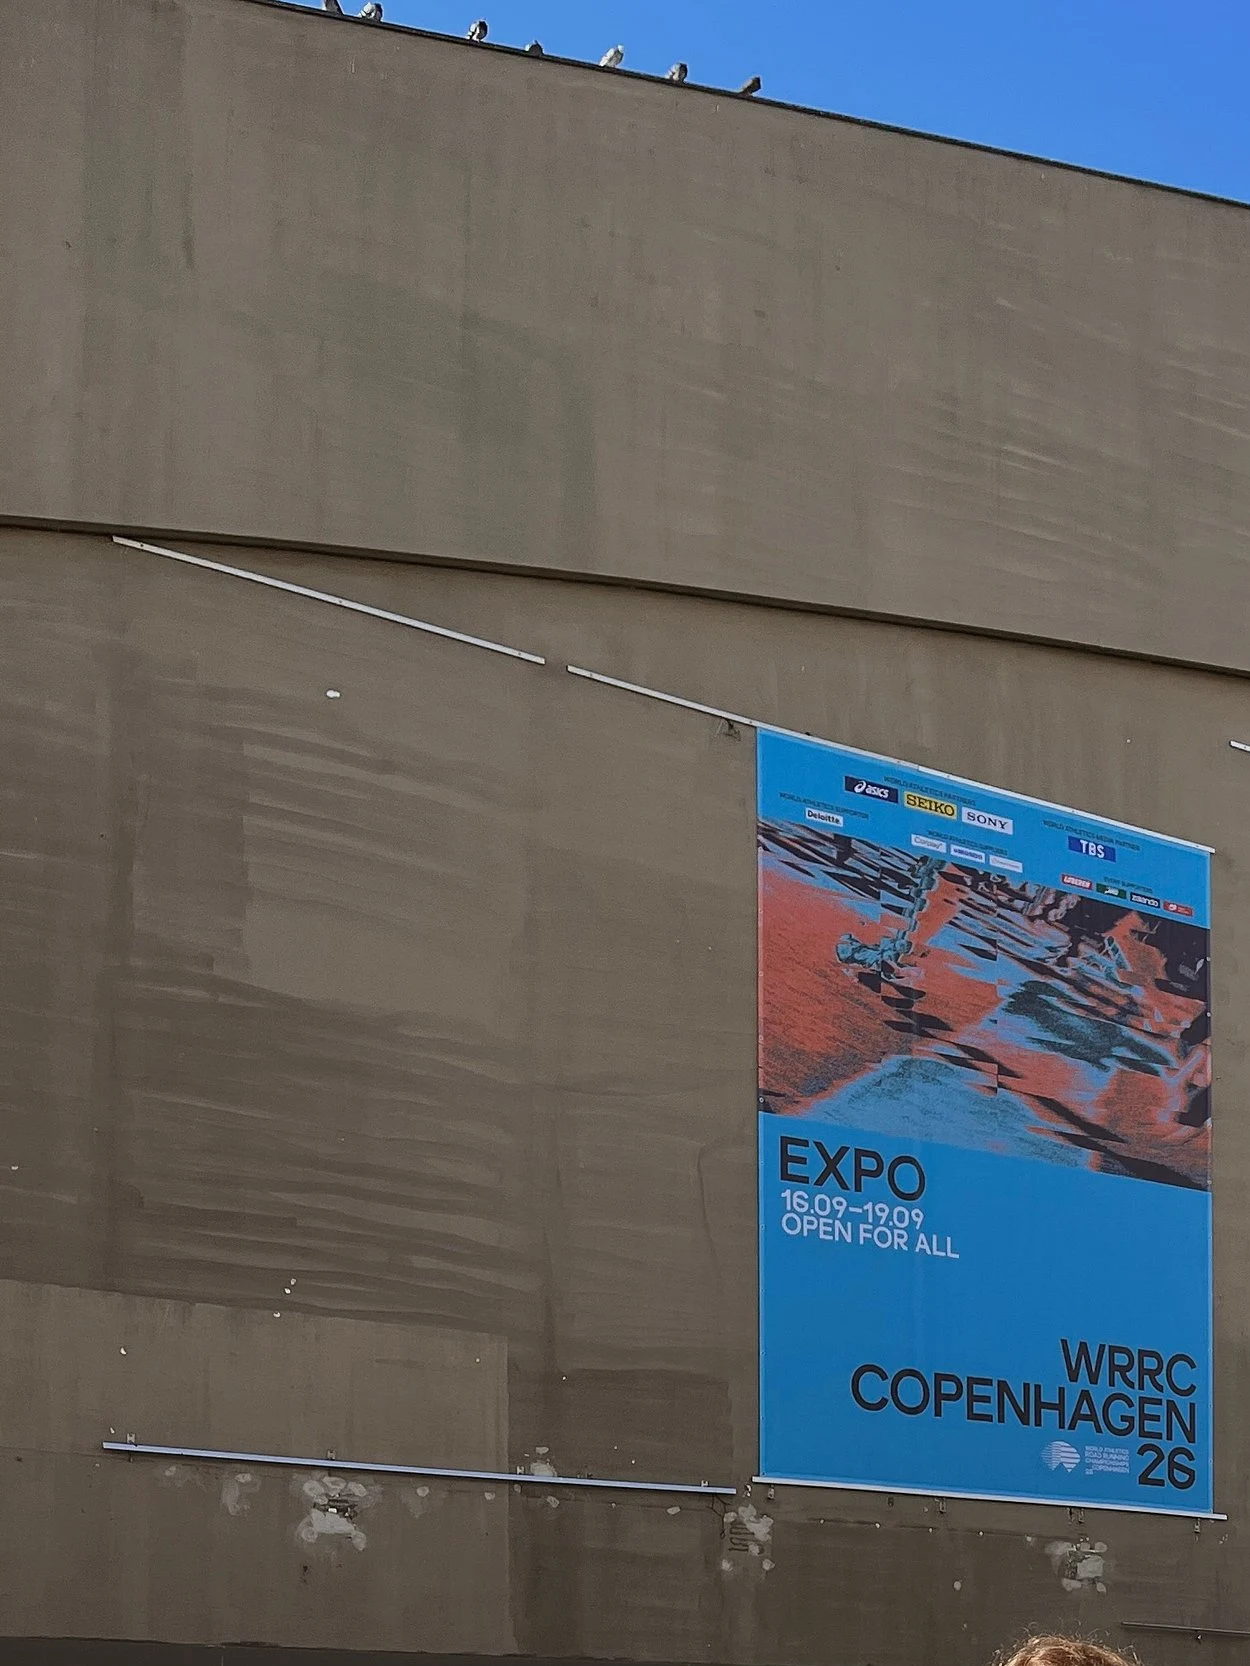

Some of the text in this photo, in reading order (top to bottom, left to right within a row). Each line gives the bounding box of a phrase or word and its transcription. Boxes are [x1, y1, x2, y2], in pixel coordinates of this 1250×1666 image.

[866, 787, 890, 799] asics
[906, 793, 955, 817] SEIKO
[966, 810, 1009, 830] SONY
[1079, 840, 1105, 858] TBS
[779, 1135, 926, 1202] EXPO
[781, 1212, 960, 1259] OPEN FOR ALL
[1060, 1338, 1197, 1397] WRRC
[851, 1363, 1196, 1444] COPENHAGEN
[1136, 1442, 1196, 1490] 26
